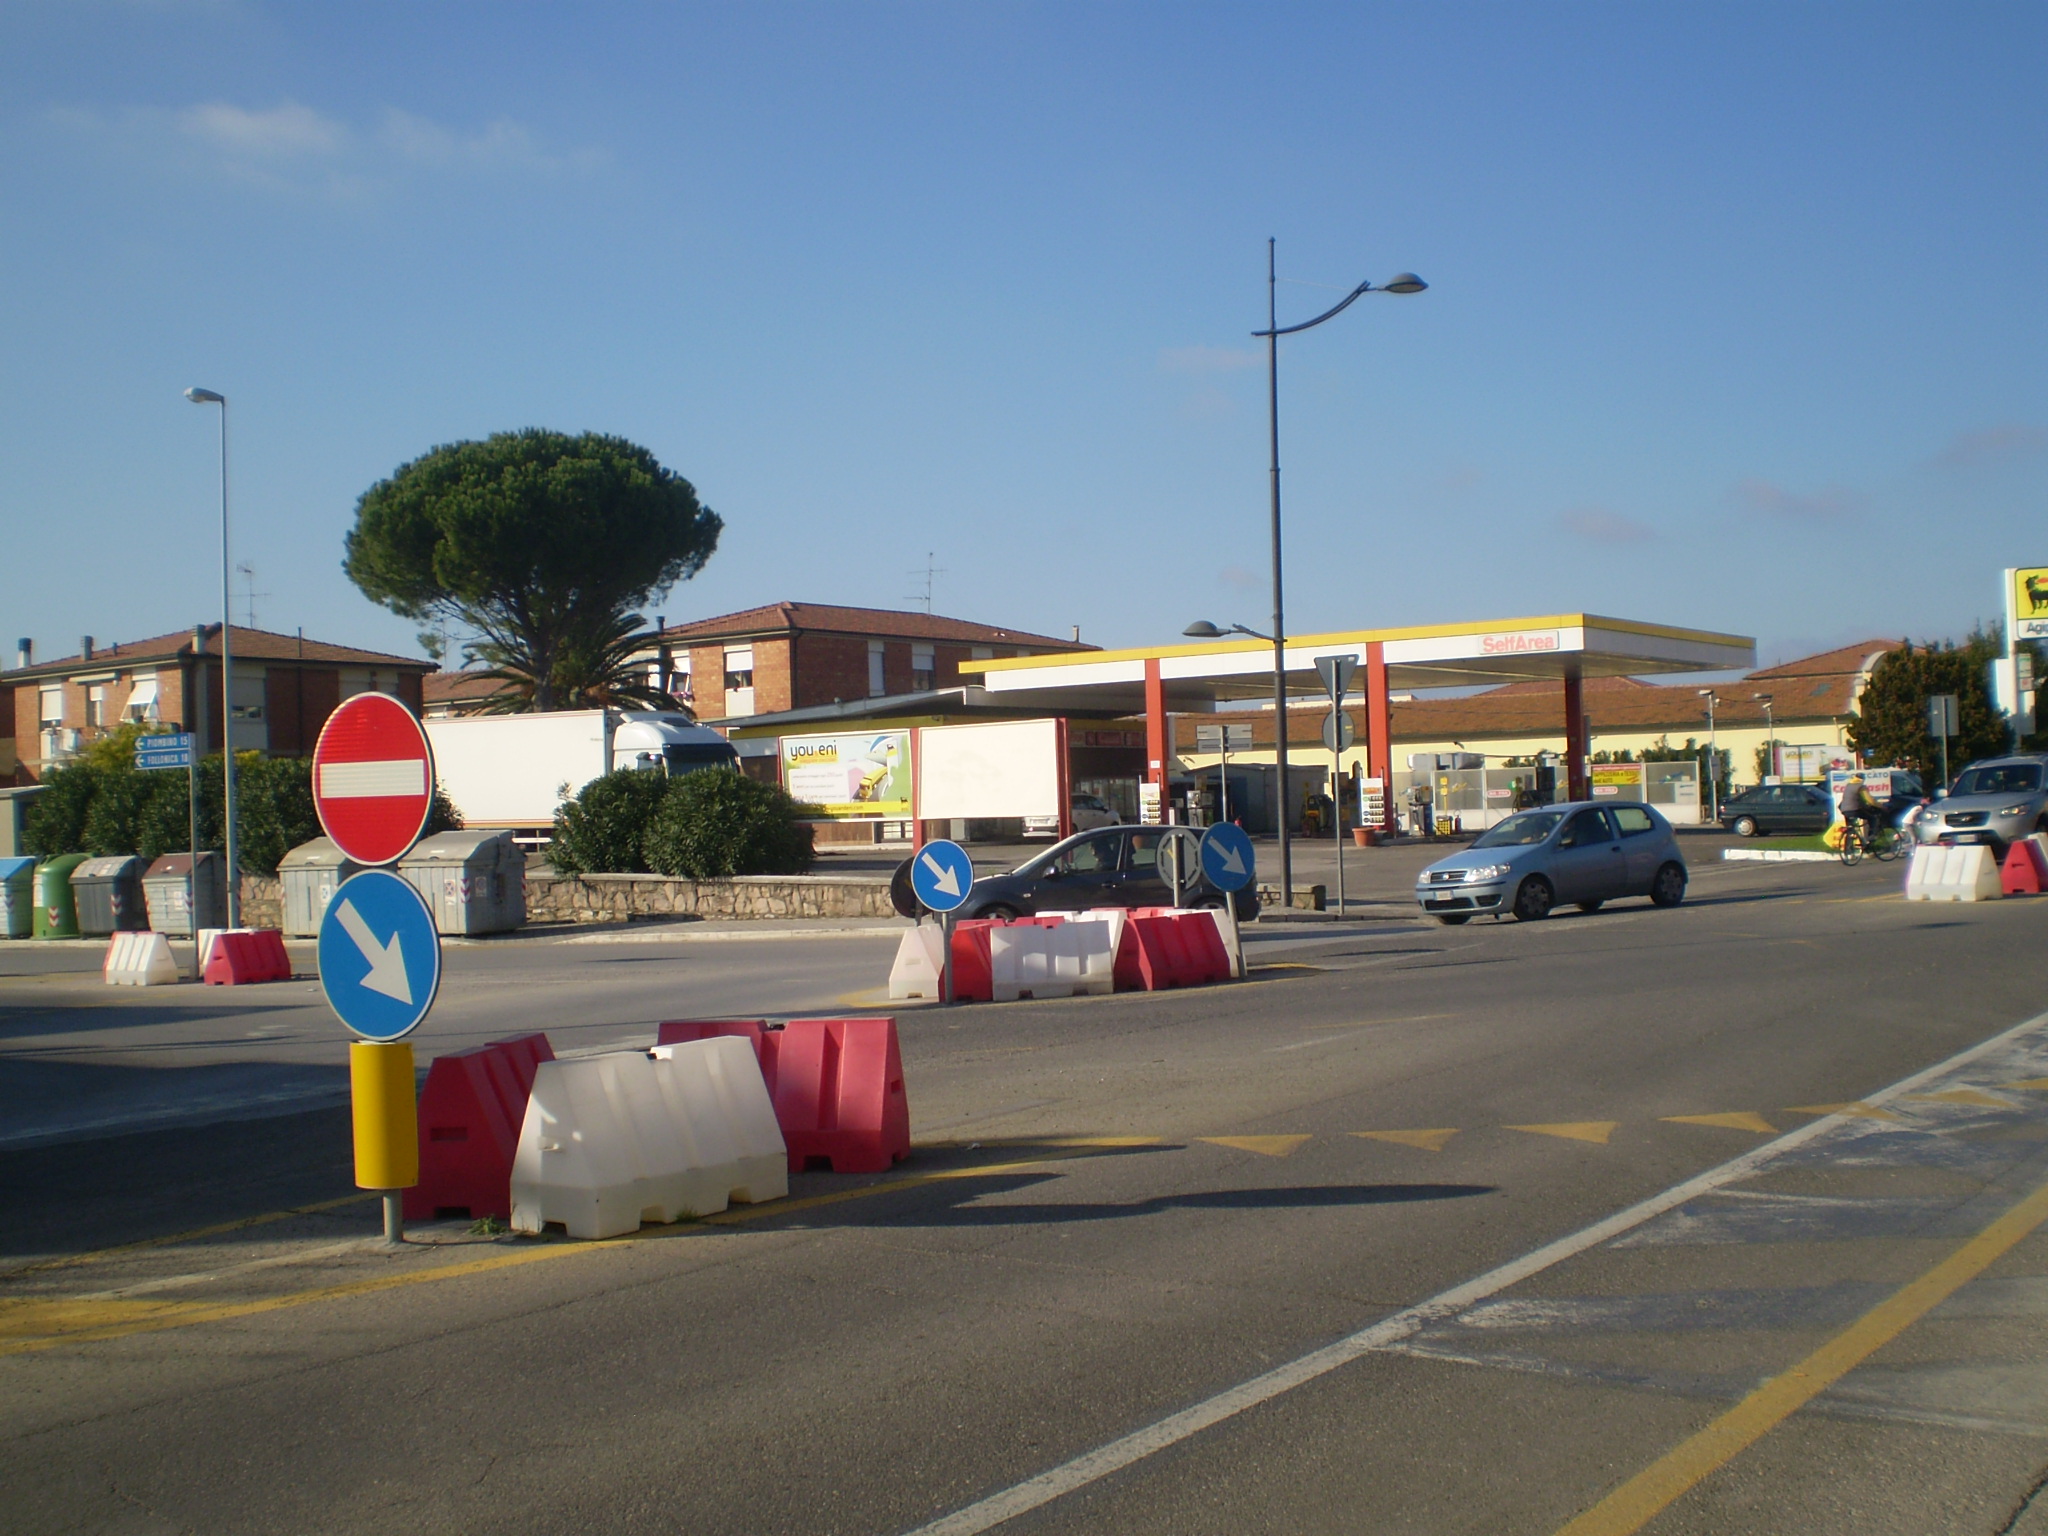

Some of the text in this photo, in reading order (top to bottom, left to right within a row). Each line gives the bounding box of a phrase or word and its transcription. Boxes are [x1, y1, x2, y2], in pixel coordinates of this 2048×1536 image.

[147, 736, 188, 747] PIOMBINO 15
[147, 754, 178, 765] FOLLONICA
